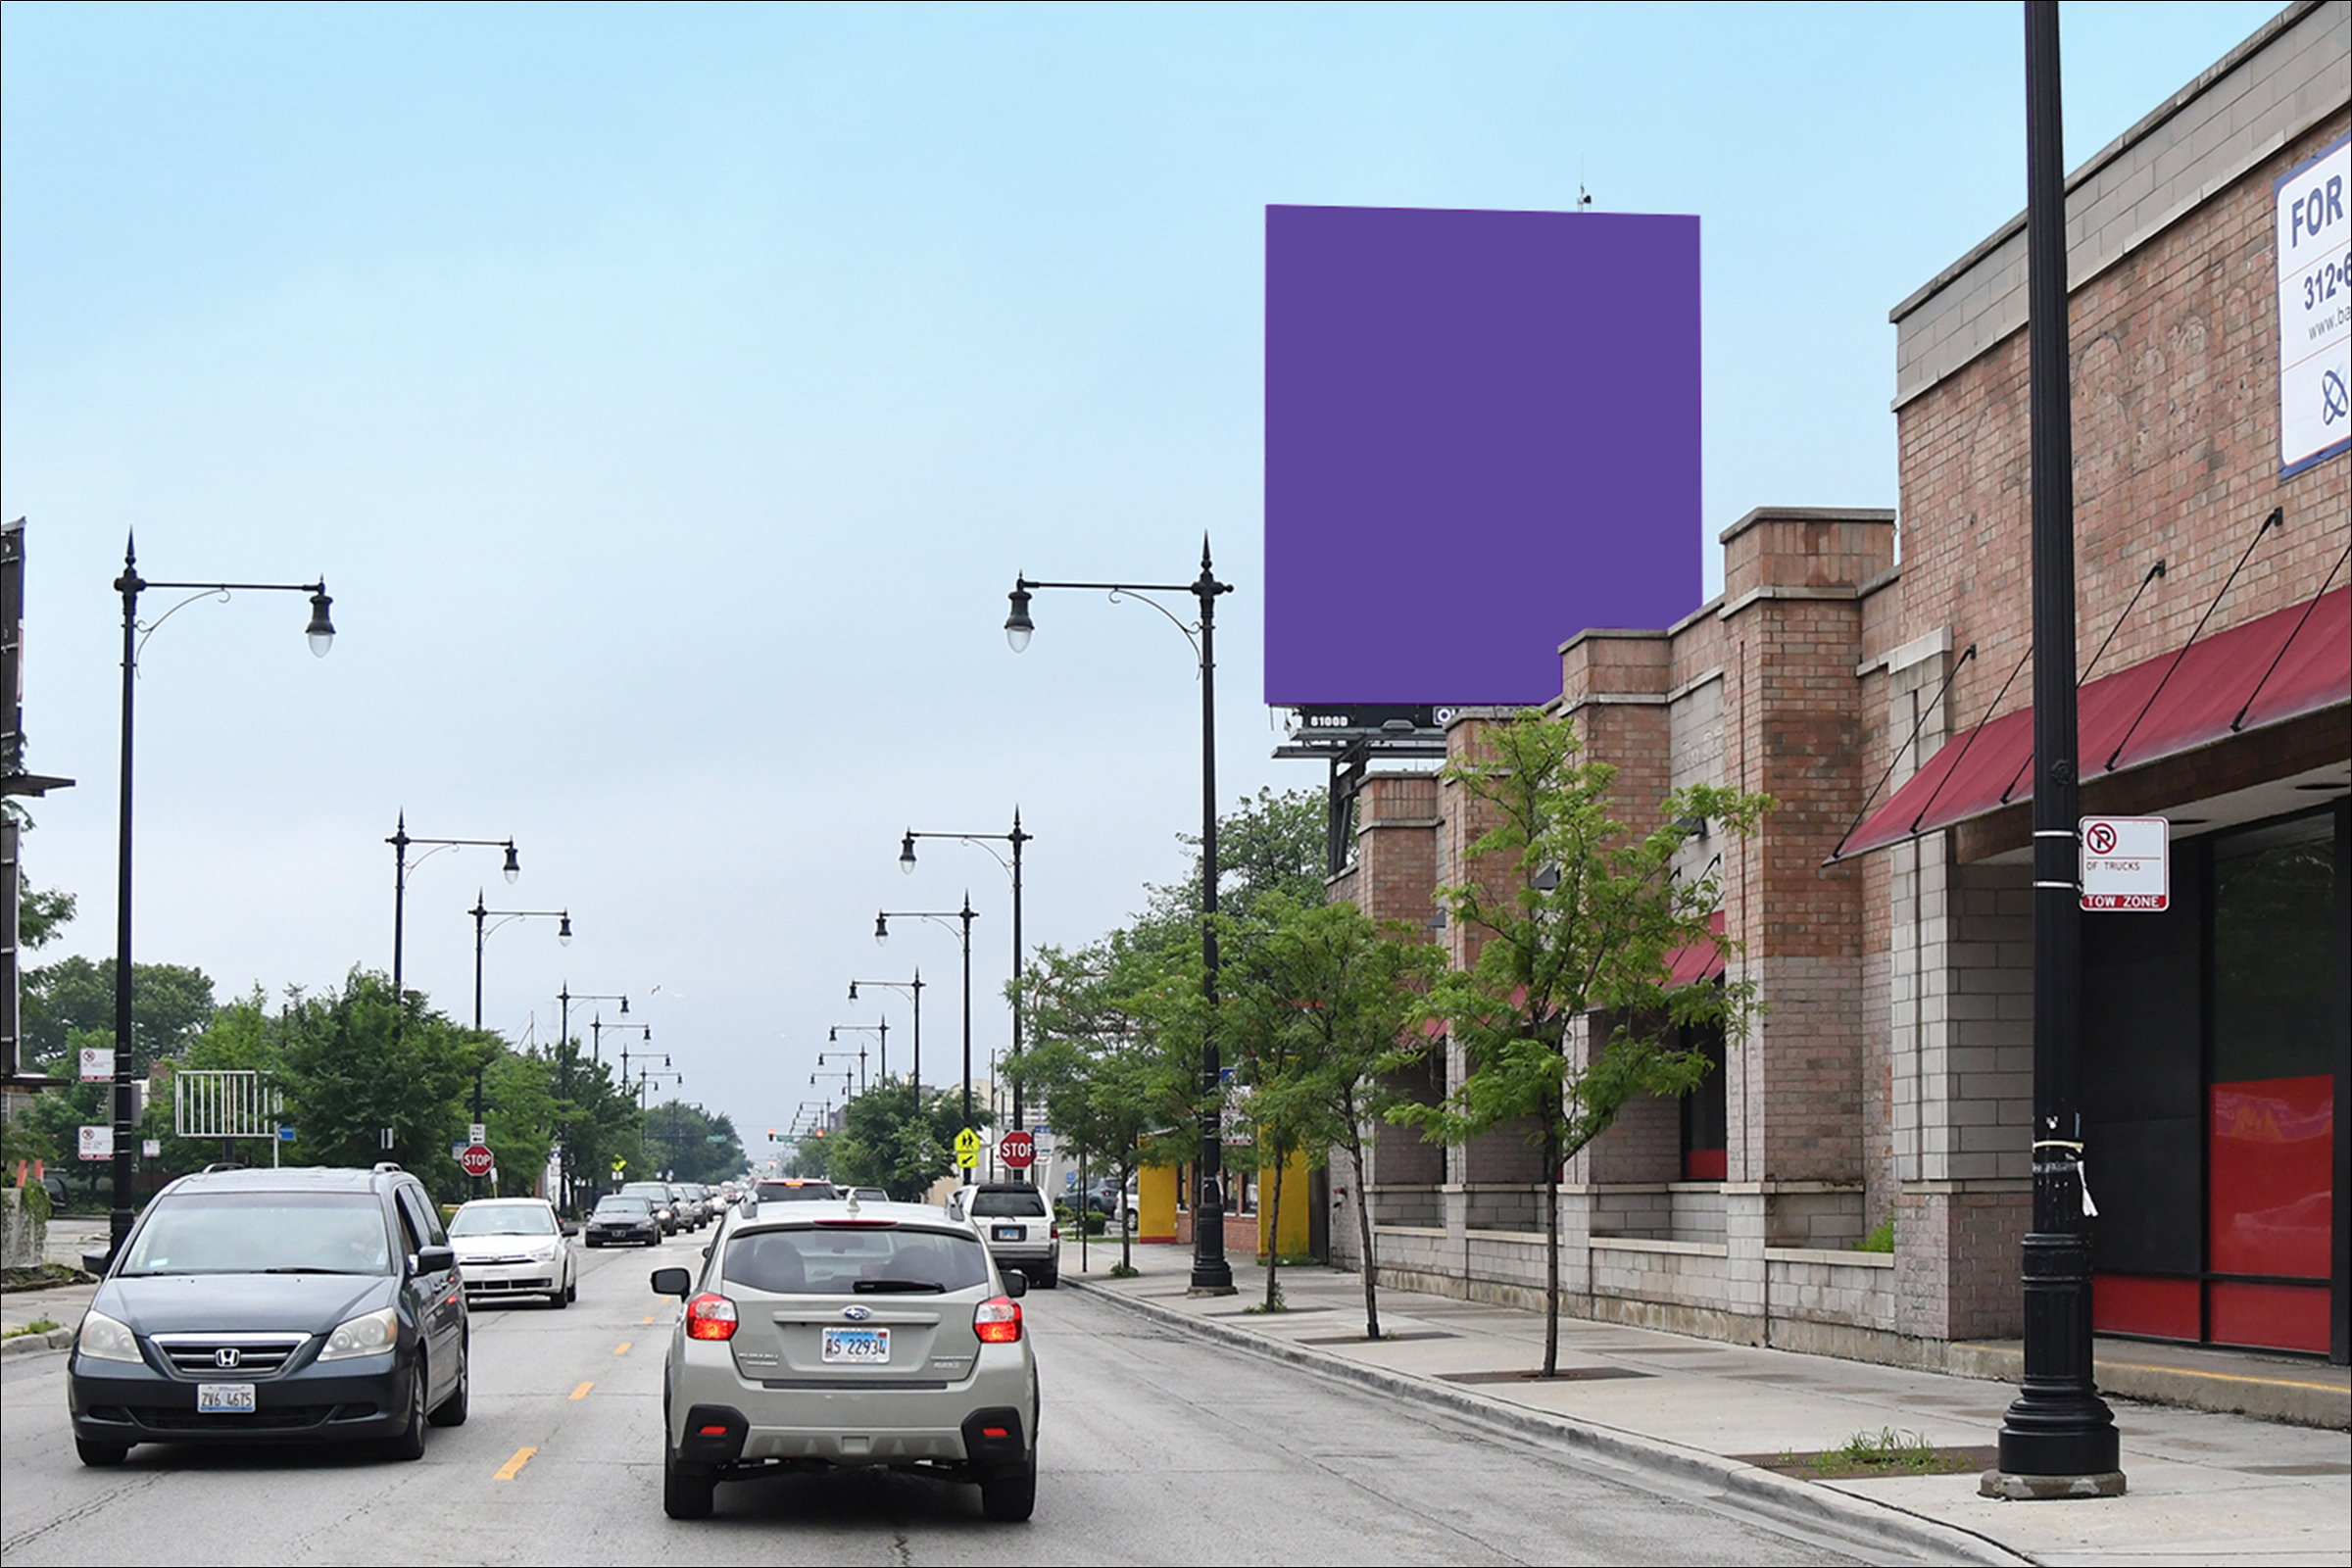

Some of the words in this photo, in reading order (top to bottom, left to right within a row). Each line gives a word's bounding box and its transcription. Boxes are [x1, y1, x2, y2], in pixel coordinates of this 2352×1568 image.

[2292, 174, 2343, 249] FOR
[1310, 715, 1348, 727] 8100D
[2086, 861, 2097, 871] OF
[2104, 861, 2140, 871] TRUCKS
[2087, 896, 2116, 907] TOW
[2123, 896, 2159, 907] ZONE
[464, 1154, 491, 1166] STOP
[825, 1338, 841, 1354] AS
[848, 1338, 886, 1355] 22934
